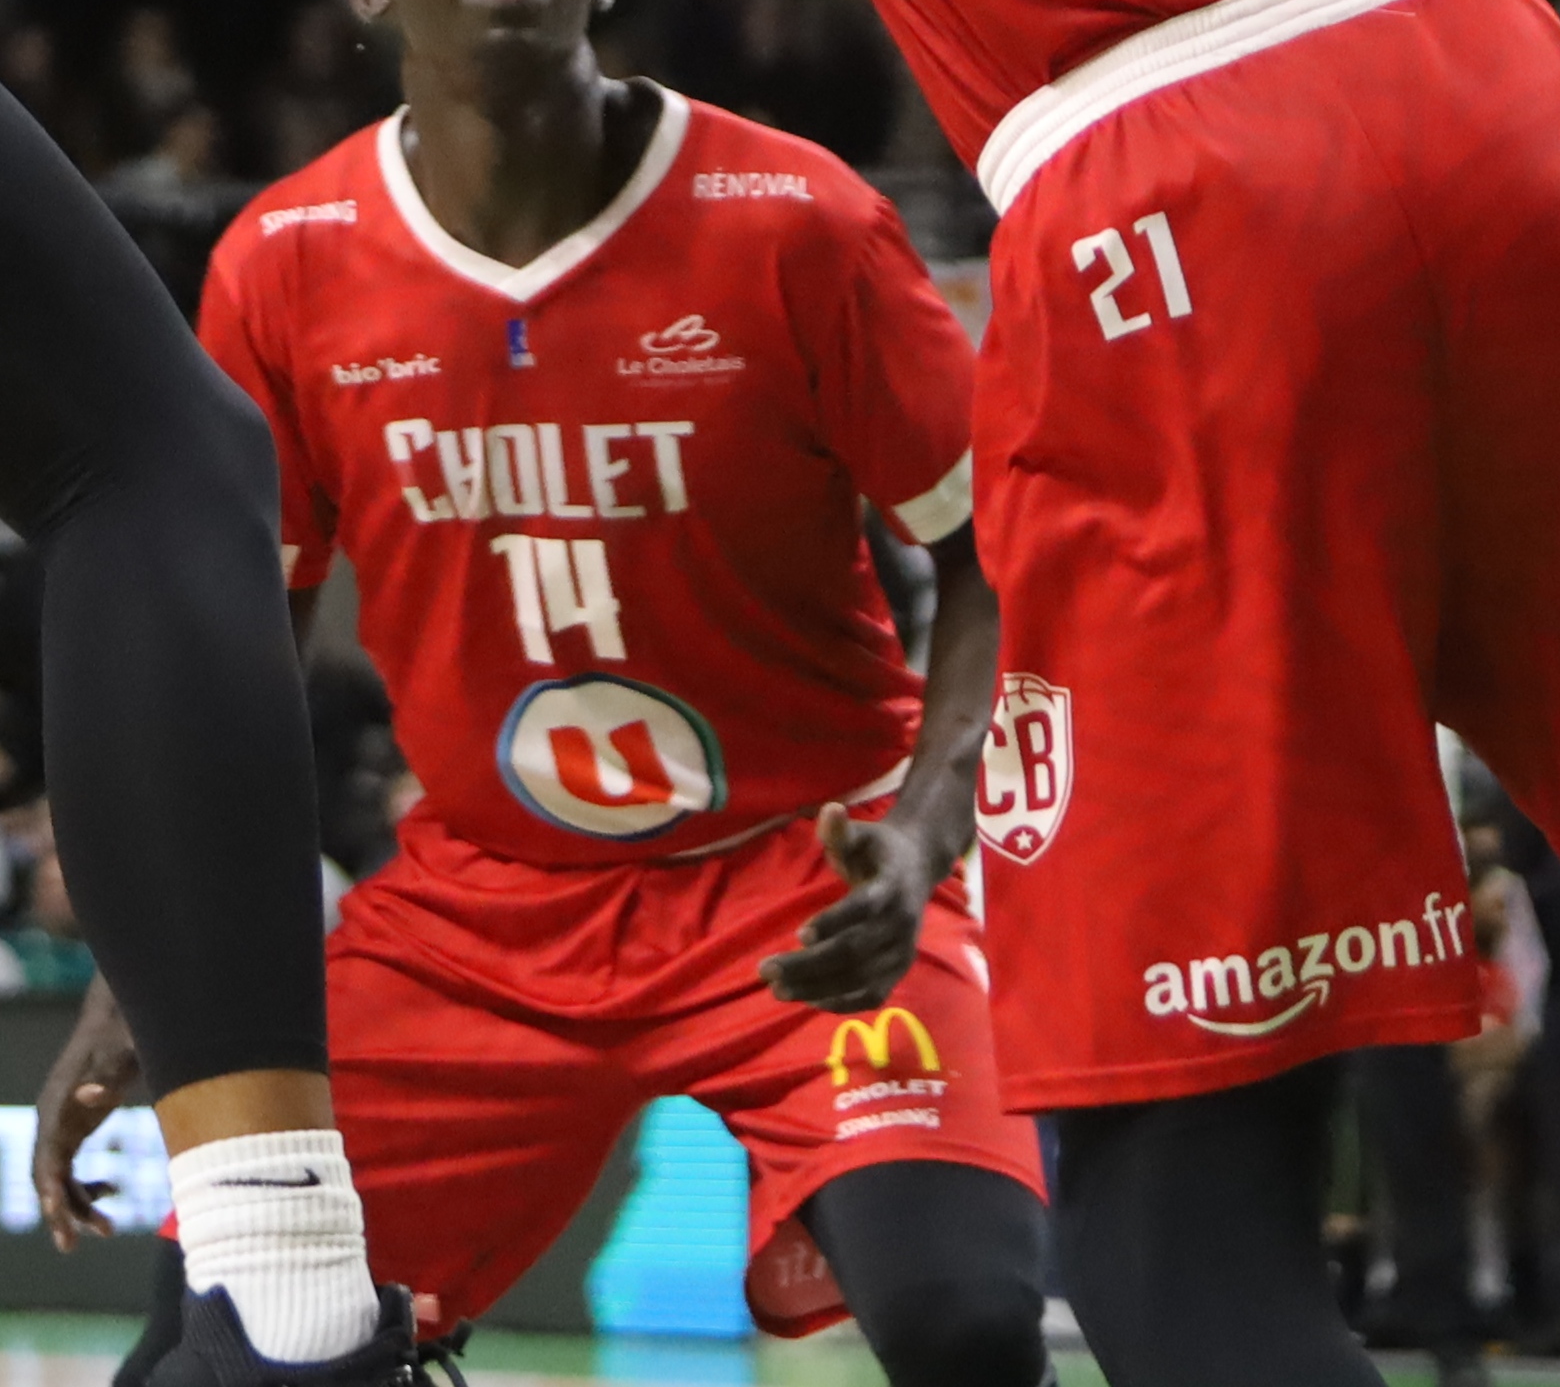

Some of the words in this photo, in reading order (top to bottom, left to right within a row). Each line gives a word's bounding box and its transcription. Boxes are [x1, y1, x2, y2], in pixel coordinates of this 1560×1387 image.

[1071, 211, 1192, 341] 21
[383, 418, 695, 523] CHOLET
[491, 534, 626, 665] 14
[1143, 891, 1465, 1016] amazon.fr
